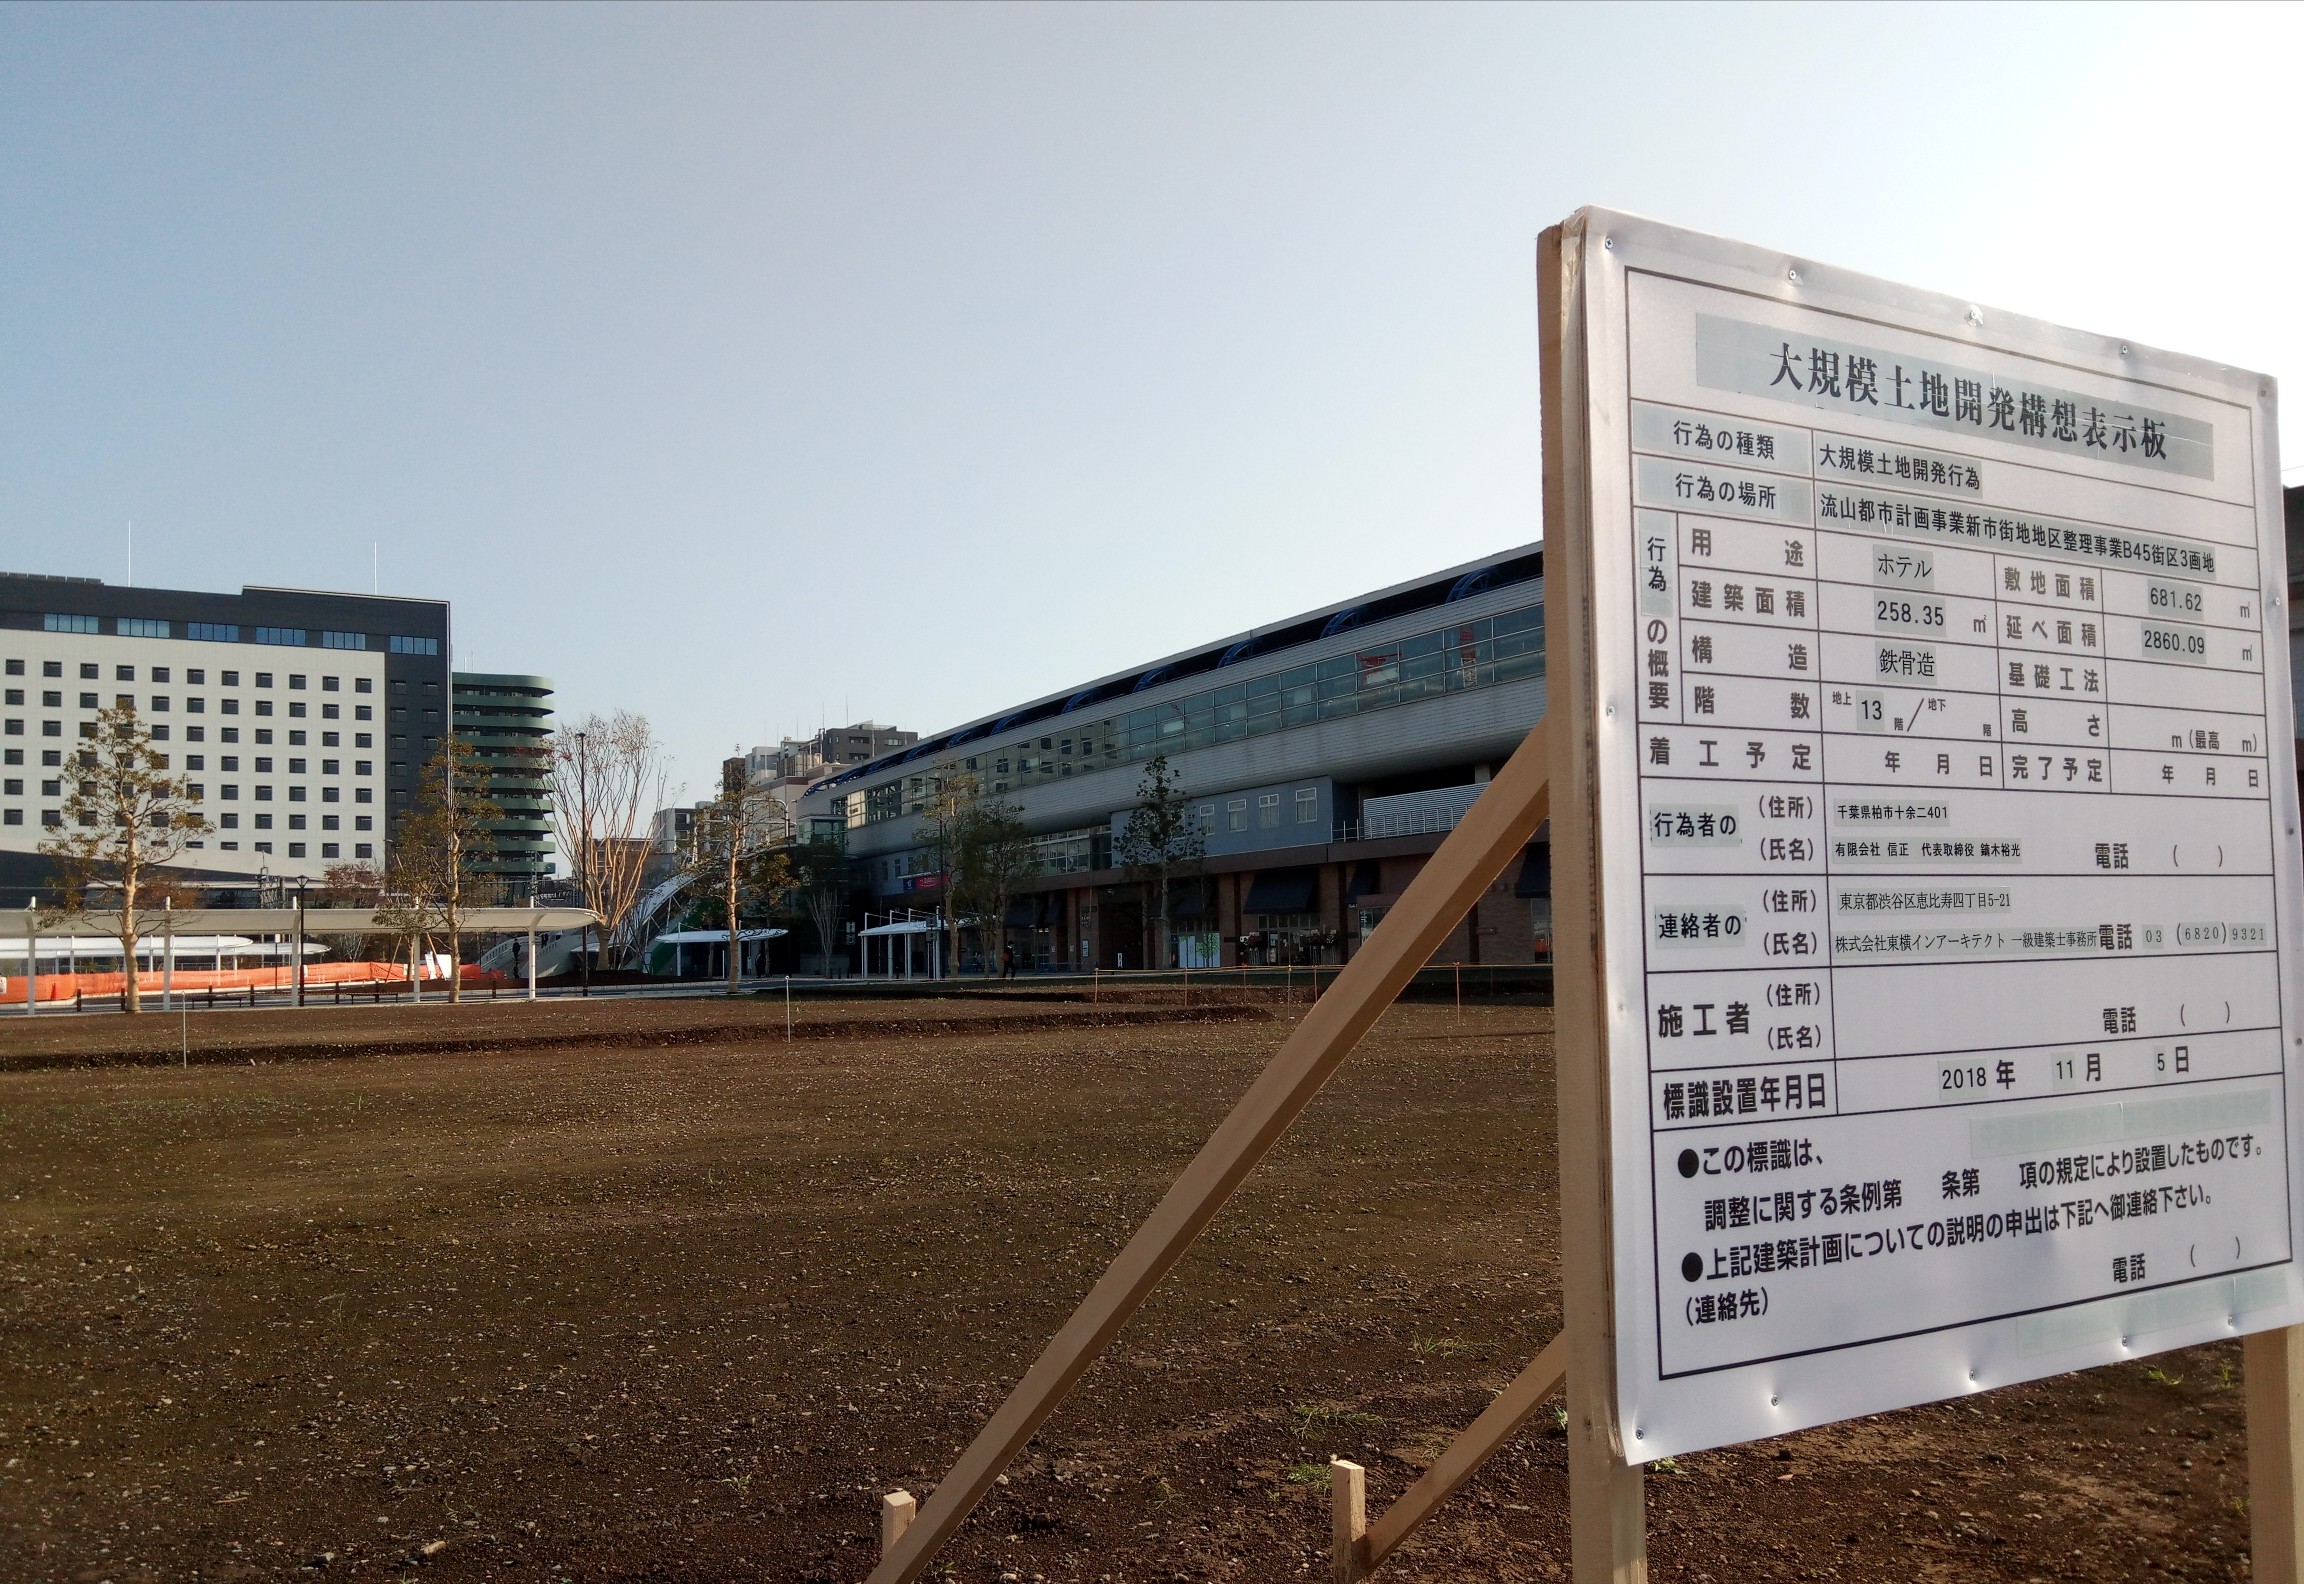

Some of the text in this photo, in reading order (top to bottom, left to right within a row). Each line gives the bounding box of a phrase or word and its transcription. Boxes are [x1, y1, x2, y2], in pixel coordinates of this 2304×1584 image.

[1770, 341, 2167, 461] 大規模土地開発構想表示板
[1673, 420, 1775, 461] 行為の種類
[1819, 443, 1980, 490] 大規模土地開発行為
[1675, 472, 1777, 510] 行為の場所
[1820, 493, 2215, 573] 流山都市計画事業新市街地地区整理事業B45街区3画地
[1877, 553, 1932, 579] ホテル
[1691, 580, 1805, 618] 建築面積
[2004, 566, 2095, 601] 敷地面積
[2150, 587, 2203, 612] 681.62
[1647, 536, 1670, 710] 行為の概要
[1877, 600, 1944, 626] 258.35
[2006, 615, 2097, 648] 延べ面積
[2144, 630, 2205, 655] 2860.09
[1879, 648, 1935, 677] 鉄骨造
[2008, 661, 2100, 694] 基礎工法
[1832, 691, 1904, 731] 地上 13 階
[1928, 698, 1992, 737] 地下 階
[2012, 755, 2103, 783] 完了予定
[1654, 811, 1736, 837] 行為者の
[1837, 805, 1948, 820] 千葉県柏市十余二401
[1835, 843, 1881, 857] 有限会社
[1887, 843, 1910, 857] 信正
[1921, 843, 1975, 857] 代表取締役
[2095, 843, 2129, 869] 電話
[1839, 892, 2011, 911] 東京都渋谷区恵比寿四丁目5-21
[1658, 912, 1742, 939] 連絡者の
[1835, 931, 2097, 953] 株式会社東横インアーキテクト 一級建築士事務所
[2099, 923, 2133, 950] 電話
[2146, 930, 2163, 943] 03
[2232, 928, 2265, 941] 9321
[1658, 1001, 1750, 1038] 施工者
[2103, 1006, 2137, 1034] 電話
[1942, 1067, 1986, 1090] 2018
[2056, 1060, 2073, 1080] 11
[2157, 1053, 2165, 1072] 5
[1664, 1073, 1826, 1120] 標識設置年月日
[1704, 1133, 2262, 1232] 調整に関する条例第 条第 項の規定により設置したものです。
[1706, 1184, 2212, 1281] 上記建築計画についての説明の申出は下記へ御連絡下さい。
[2112, 1252, 2146, 1284] 電話
[1686, 1286, 1769, 1327] (連絡先)
